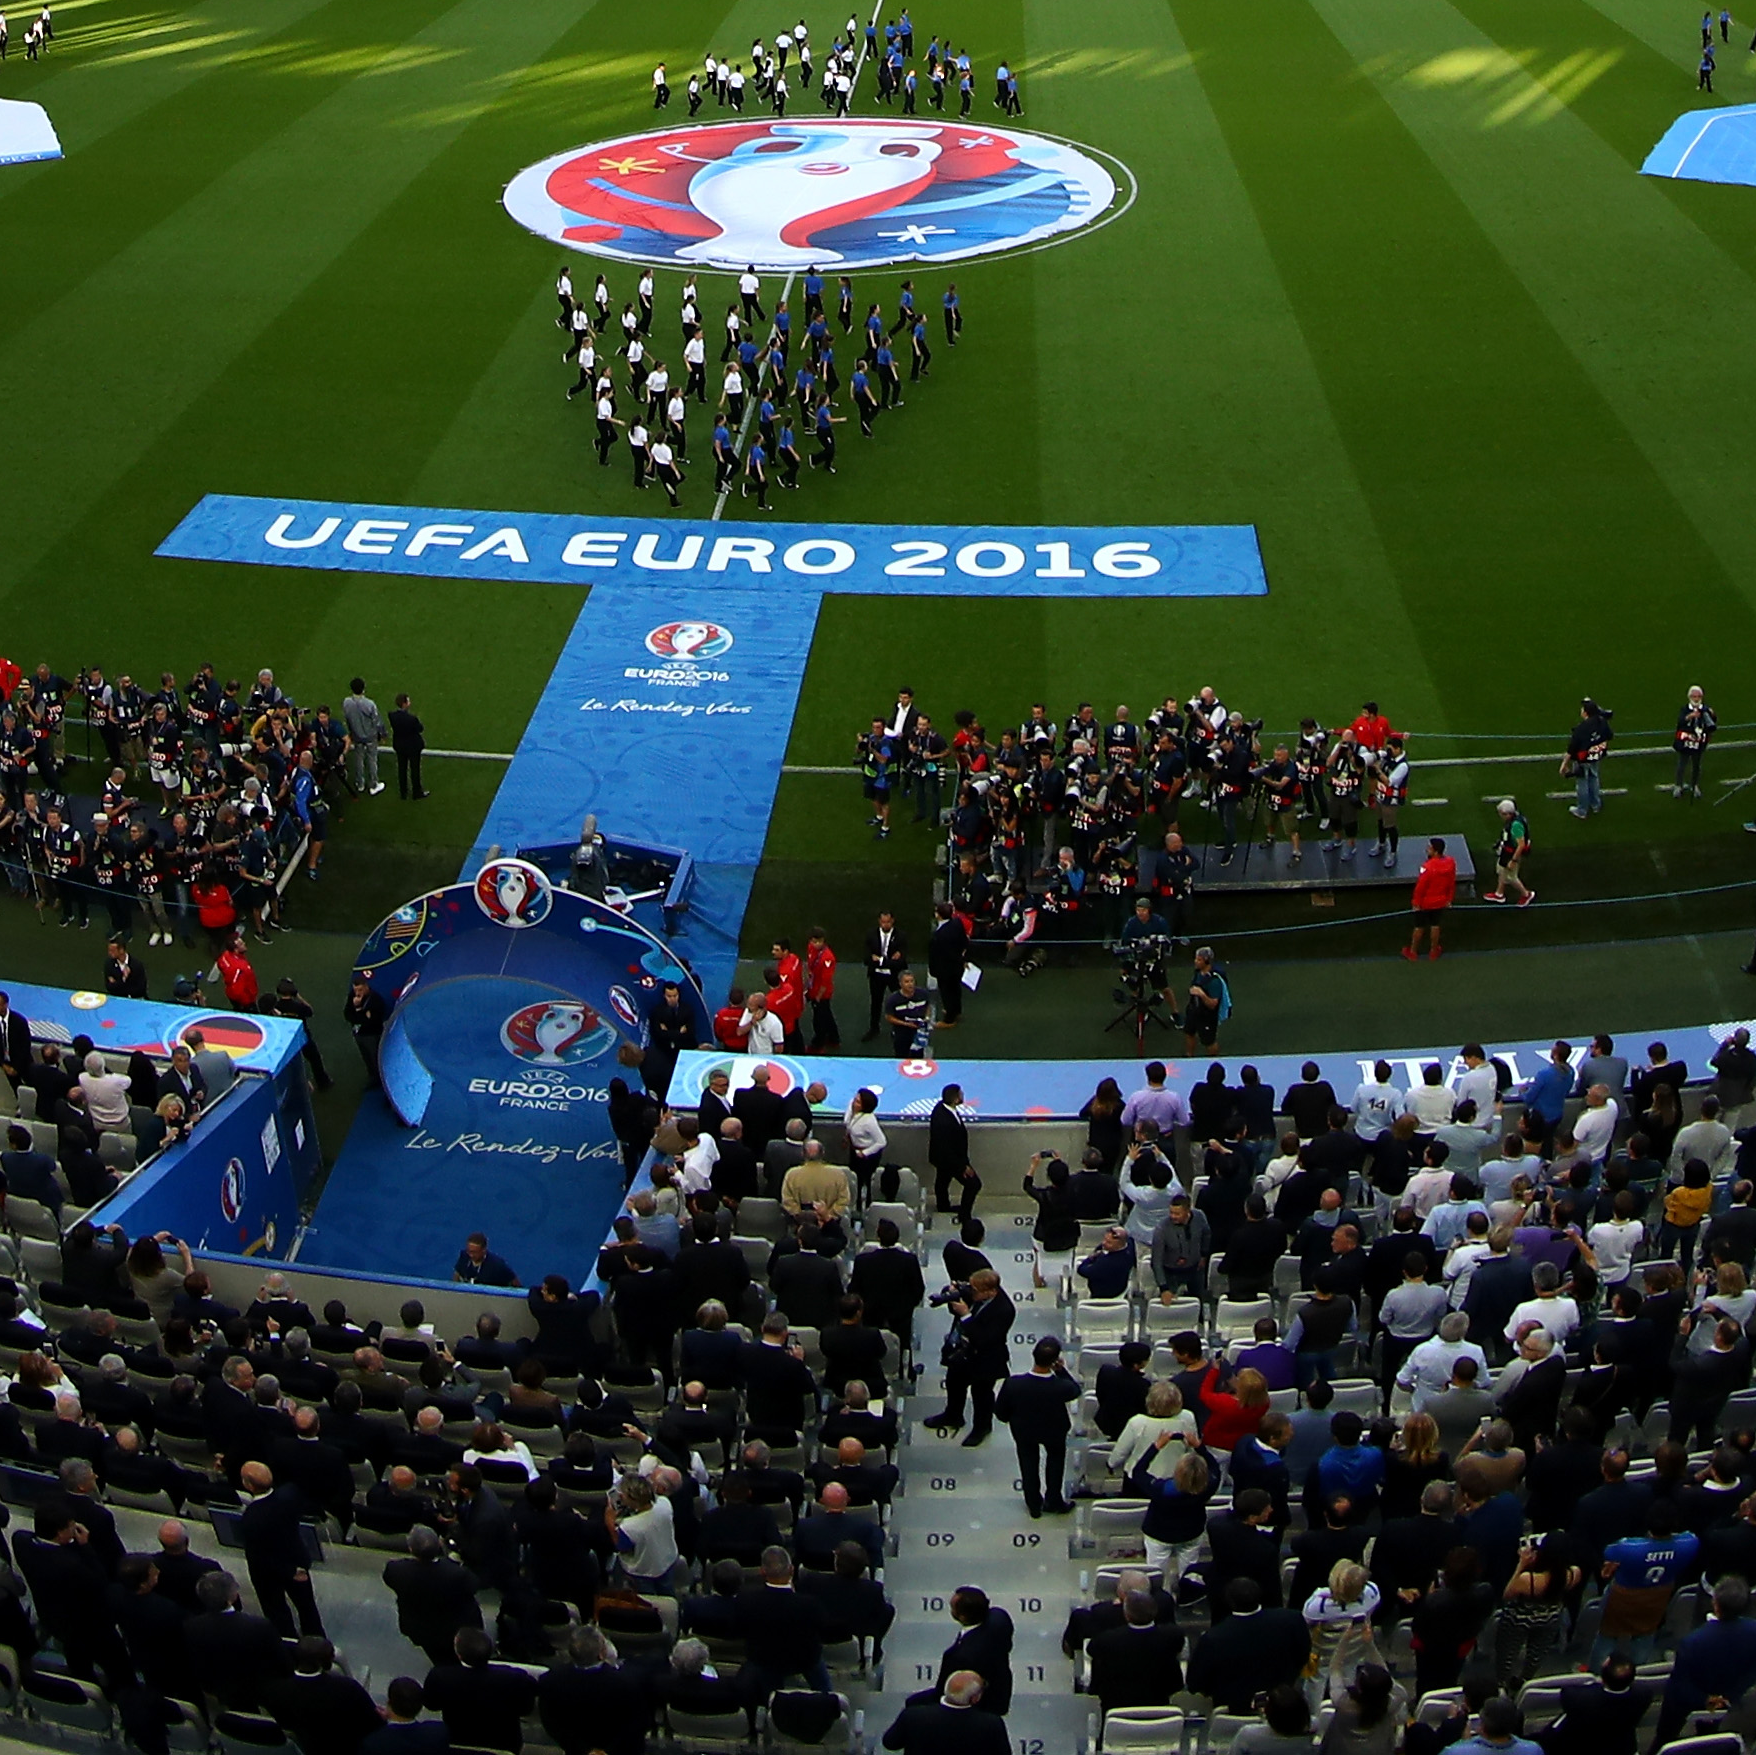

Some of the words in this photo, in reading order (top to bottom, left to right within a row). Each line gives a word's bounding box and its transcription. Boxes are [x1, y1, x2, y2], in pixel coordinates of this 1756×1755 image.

[263, 513, 532, 565] UEFA
[560, 530, 857, 576] EURO
[883, 538, 1162, 580] 2016
[623, 667, 731, 683] EURO2016
[647, 678, 701, 688] FRANCE
[579, 697, 608, 712] Le
[610, 698, 753, 718] Rendez-Vous
[519, 1068, 571, 1085] UEFA
[468, 1078, 611, 1103] EURO2016
[499, 1096, 571, 1112] FRANCE
[1368, 1097, 1386, 1111] 14
[404, 1129, 443, 1151] Le
[446, 1132, 625, 1165] Rendez-Vou
[1014, 1215, 1035, 1228] 02
[1014, 1252, 1036, 1265] 03
[1013, 1291, 1036, 1304] 04
[1013, 1333, 1038, 1346] 05
[936, 1426, 960, 1440] 07
[930, 1477, 957, 1492] 08
[926, 1533, 956, 1548] 09
[1012, 1533, 1042, 1548] 09
[922, 1597, 944, 1612] 10
[1019, 1598, 1042, 1613] 10
[914, 1664, 933, 1681] 11
[1027, 1665, 1045, 1682] 11
[1019, 1739, 1044, 1755] 12
